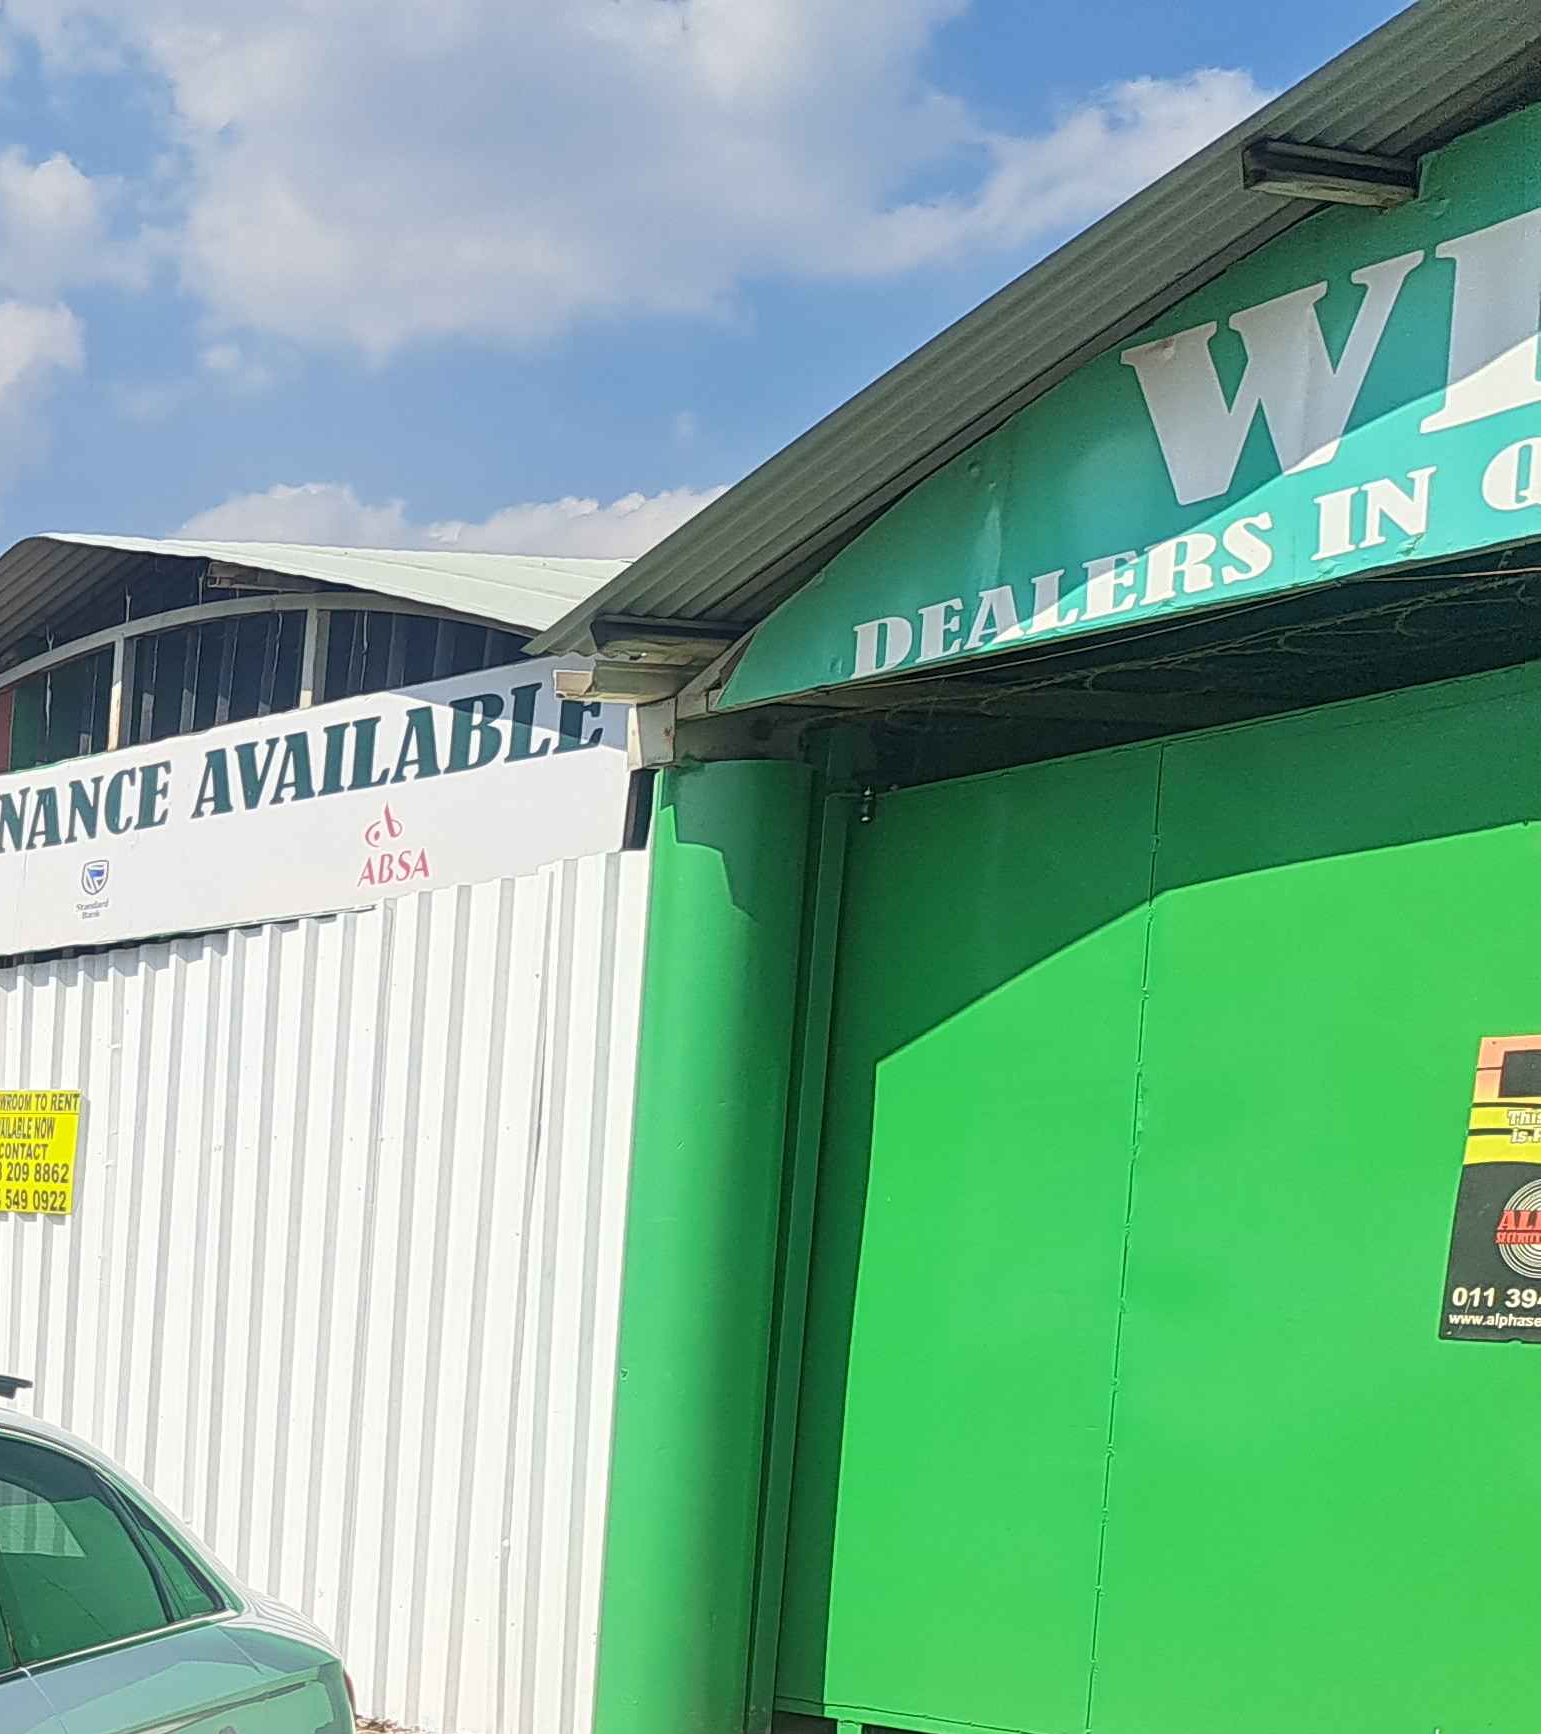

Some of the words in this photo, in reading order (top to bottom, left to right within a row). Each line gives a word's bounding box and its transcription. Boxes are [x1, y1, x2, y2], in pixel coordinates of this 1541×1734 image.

[849, 511, 1273, 680] DEALERS
[1311, 466, 1437, 561] IN
[190, 681, 605, 819] AVAILABLE
[356, 846, 431, 888] ABSA
[34, 1093, 48, 1111] TO
[51, 1093, 81, 1111] RENT
[34, 1117, 55, 1139] NOW
[6, 1162, 29, 1181] 209
[34, 1163, 70, 1183] 8862
[5, 1189, 28, 1209] 549
[33, 1190, 67, 1212] 0922
[1452, 1287, 1495, 1307] 011
[1505, 1288, 1541, 1308] 39
